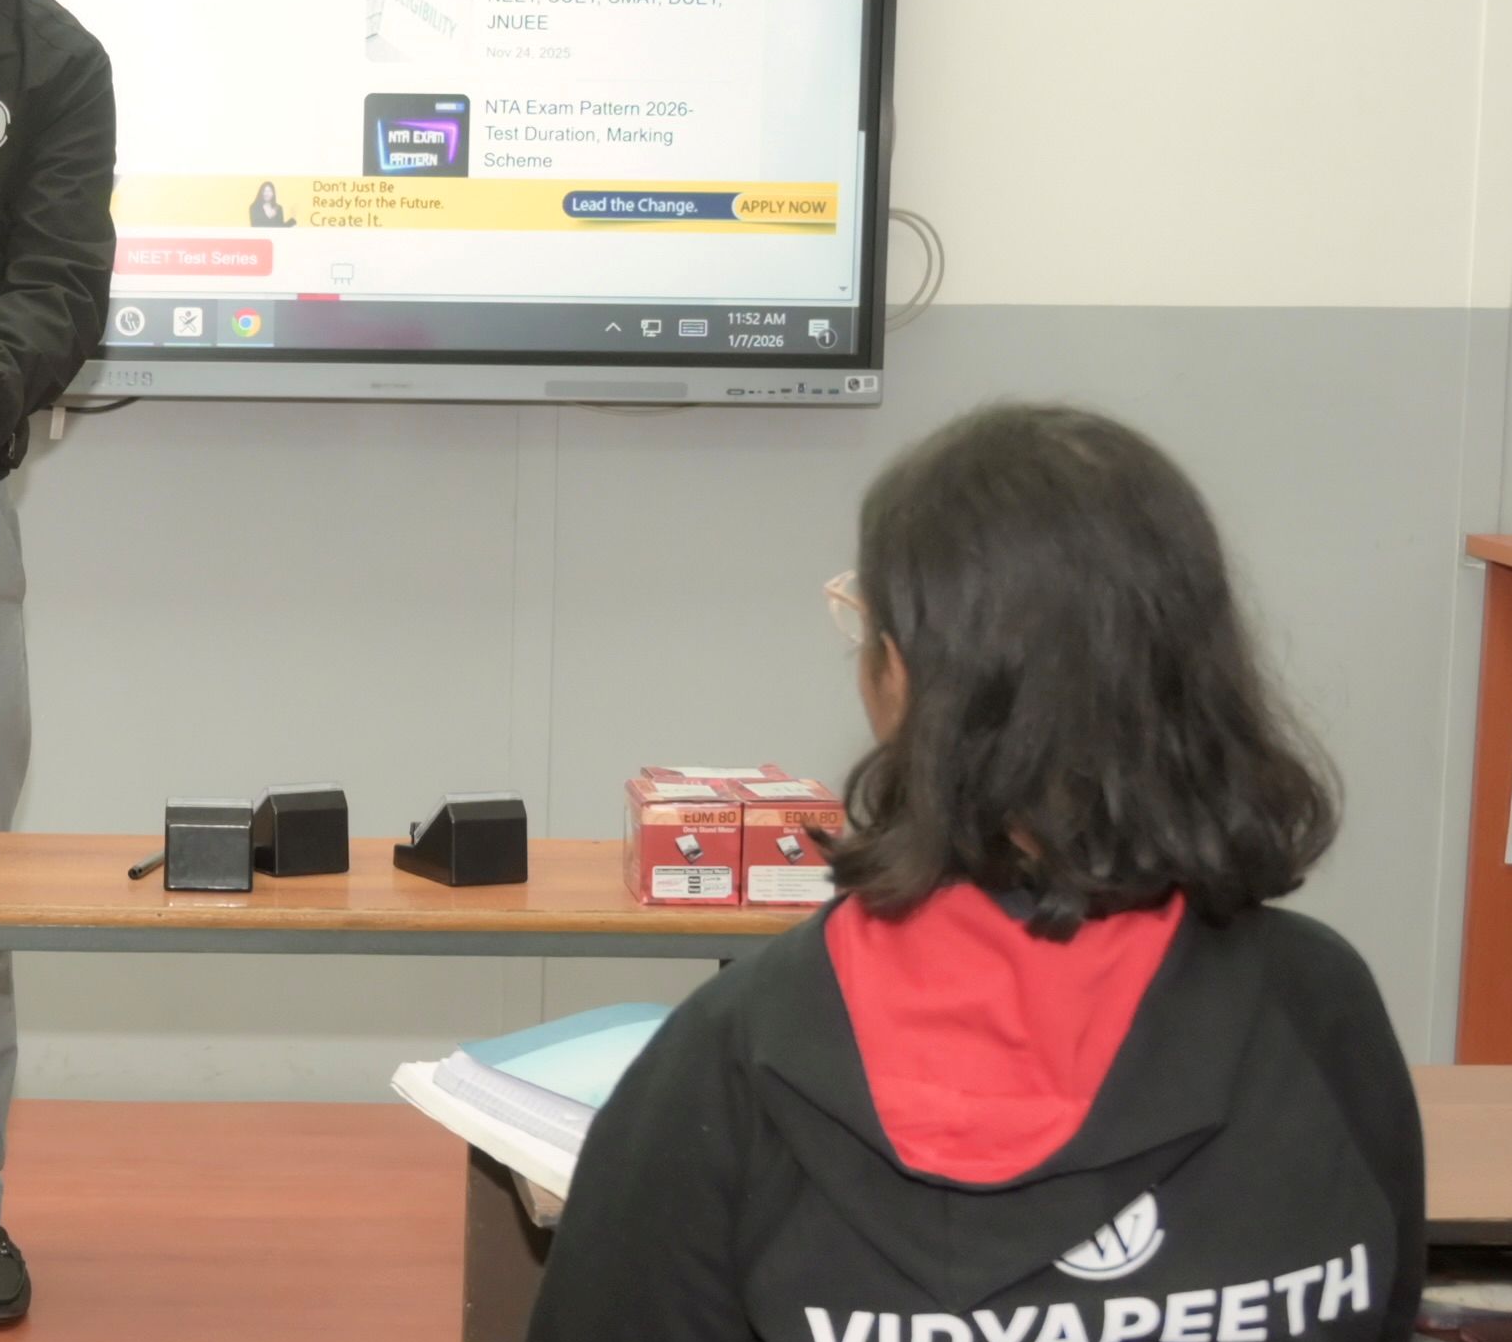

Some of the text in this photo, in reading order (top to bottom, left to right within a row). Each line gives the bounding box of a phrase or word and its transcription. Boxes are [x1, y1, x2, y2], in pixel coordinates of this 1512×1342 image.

[487, 14, 549, 31] JNUEE
[485, 99, 694, 117] NTA Exam Pattern 2026-
[413, 130, 445, 145] EXAM
[485, 126, 674, 146] Test Duration, Marking
[483, 153, 553, 169] Scheme
[312, 180, 395, 194] Don't Just Be
[312, 196, 445, 211] Ready for the Future.
[572, 197, 699, 216] Lead the Change.
[740, 200, 827, 215] APPLY NOW
[310, 212, 365, 228] Create
[128, 250, 258, 266] NEET Test Series
[727, 312, 787, 326] 11:52 AM
[727, 334, 785, 349] 1/7/2026
[718, 810, 737, 824] 80
[818, 810, 839, 824] 80
